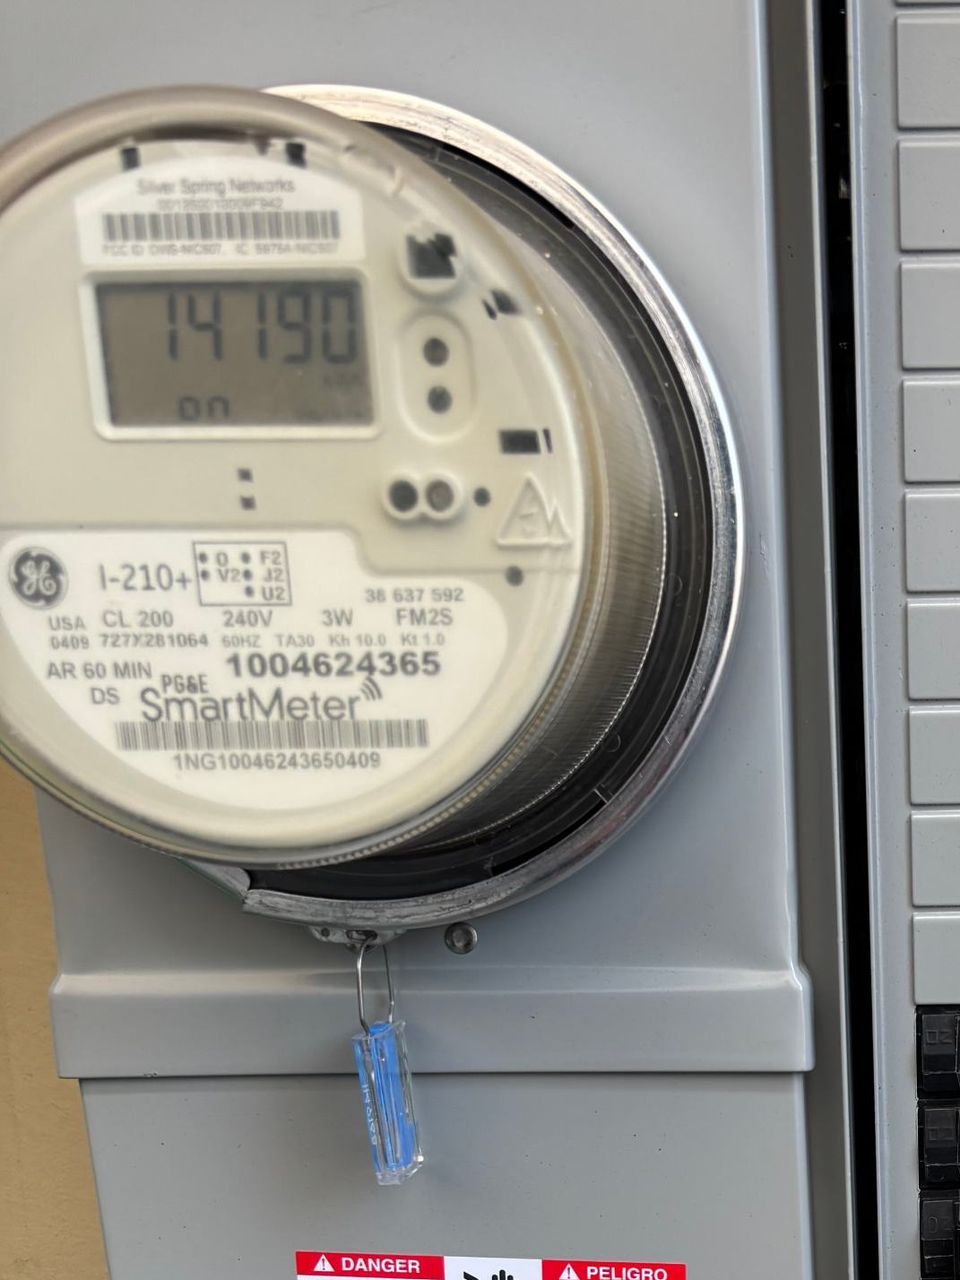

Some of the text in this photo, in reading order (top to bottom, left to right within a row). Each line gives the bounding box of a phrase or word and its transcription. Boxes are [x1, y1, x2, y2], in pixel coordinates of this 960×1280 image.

[180, 179, 225, 198] Spring
[229, 178, 295, 193] Networks
[166, 290, 360, 363] 14190
[260, 552, 281, 565] F2
[98, 564, 191, 591] I-210+
[218, 569, 284, 582] V2 J2
[262, 587, 285, 601] U2
[365, 588, 464, 602] 38 637 592
[48, 609, 453, 631] USA CL 200 240V 3W FM2S
[50, 636, 90, 649] 0409
[275, 634, 314, 647] TA30
[329, 634, 350, 646] Kh
[355, 634, 386, 646] 10.0
[402, 634, 418, 646] Kt
[422, 634, 445, 646] 1.0
[47, 662, 152, 679] AR 60 MIN
[226, 652, 441, 678] 1004624365
[161, 674, 209, 694] PG&E
[91, 688, 120, 705] DS
[139, 687, 361, 723] SmartMeter
[174, 752, 381, 771] 1NG10046243650409
[341, 1256, 421, 1274] DANGER
